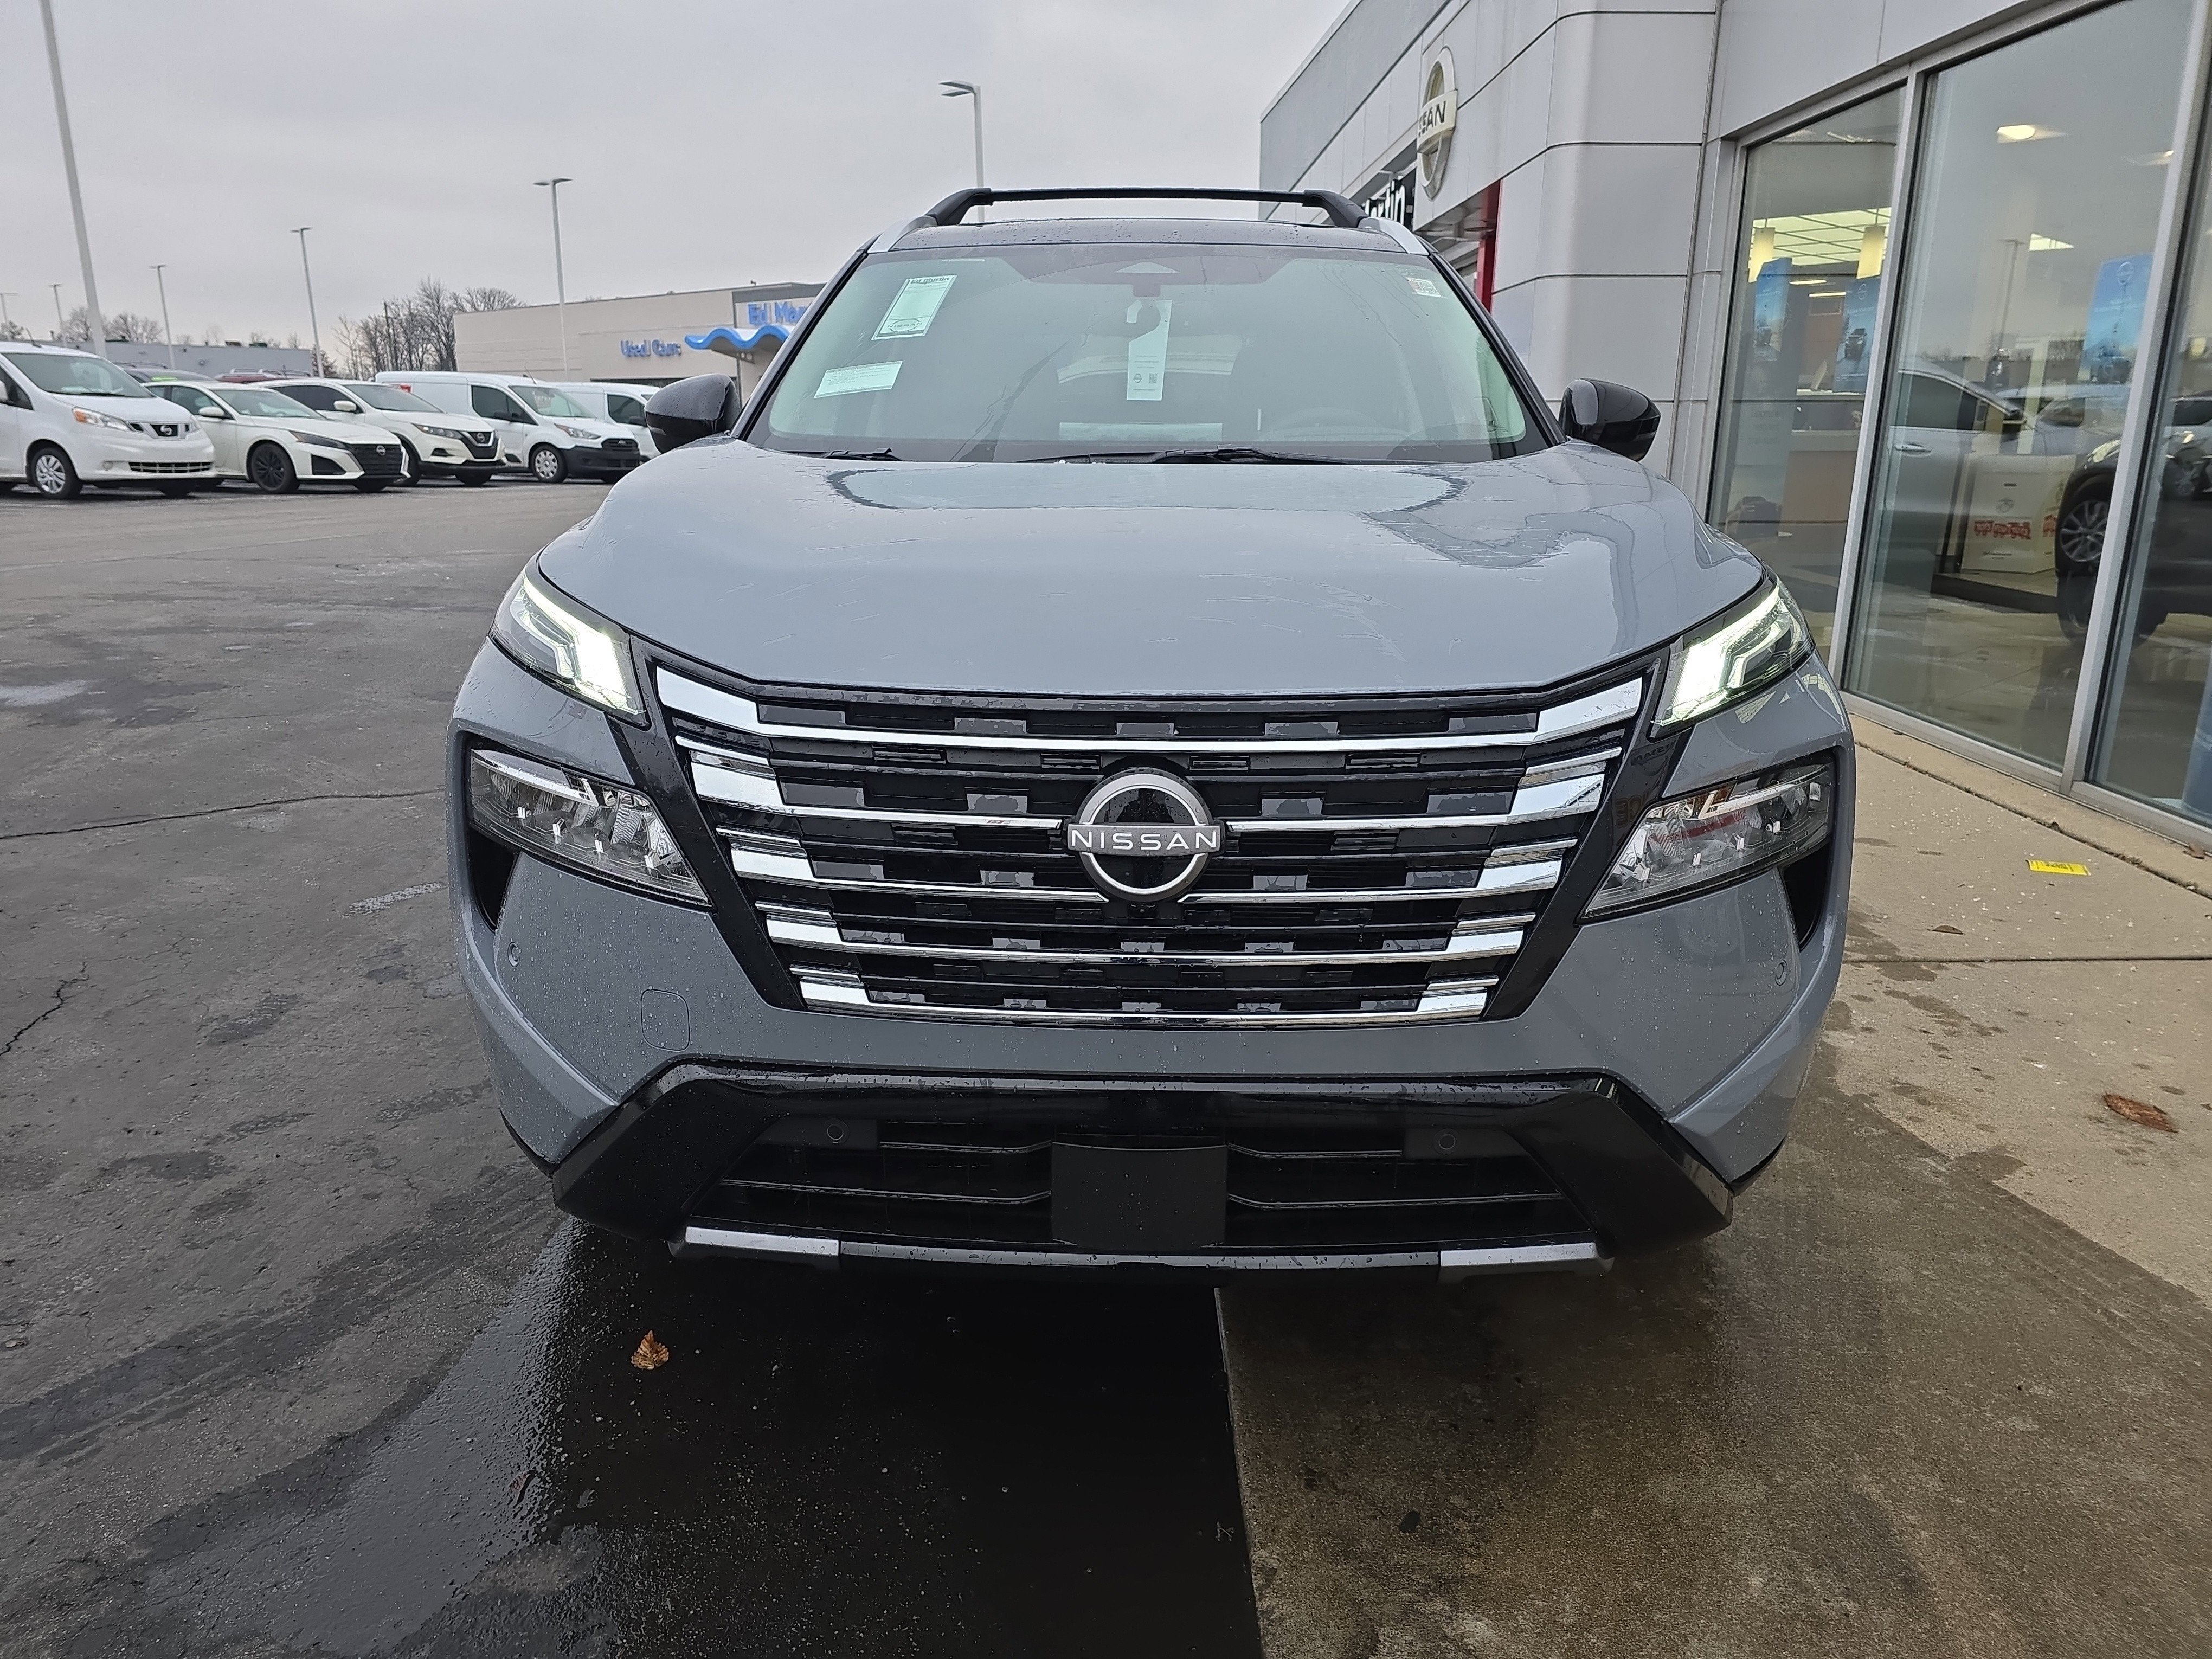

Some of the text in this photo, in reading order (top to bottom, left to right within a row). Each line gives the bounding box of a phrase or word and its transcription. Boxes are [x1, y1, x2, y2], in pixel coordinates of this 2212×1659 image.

[748, 302, 768, 325] Ed
[620, 339, 682, 357] Used Cars
[1071, 829, 1216, 850] NISSAN
